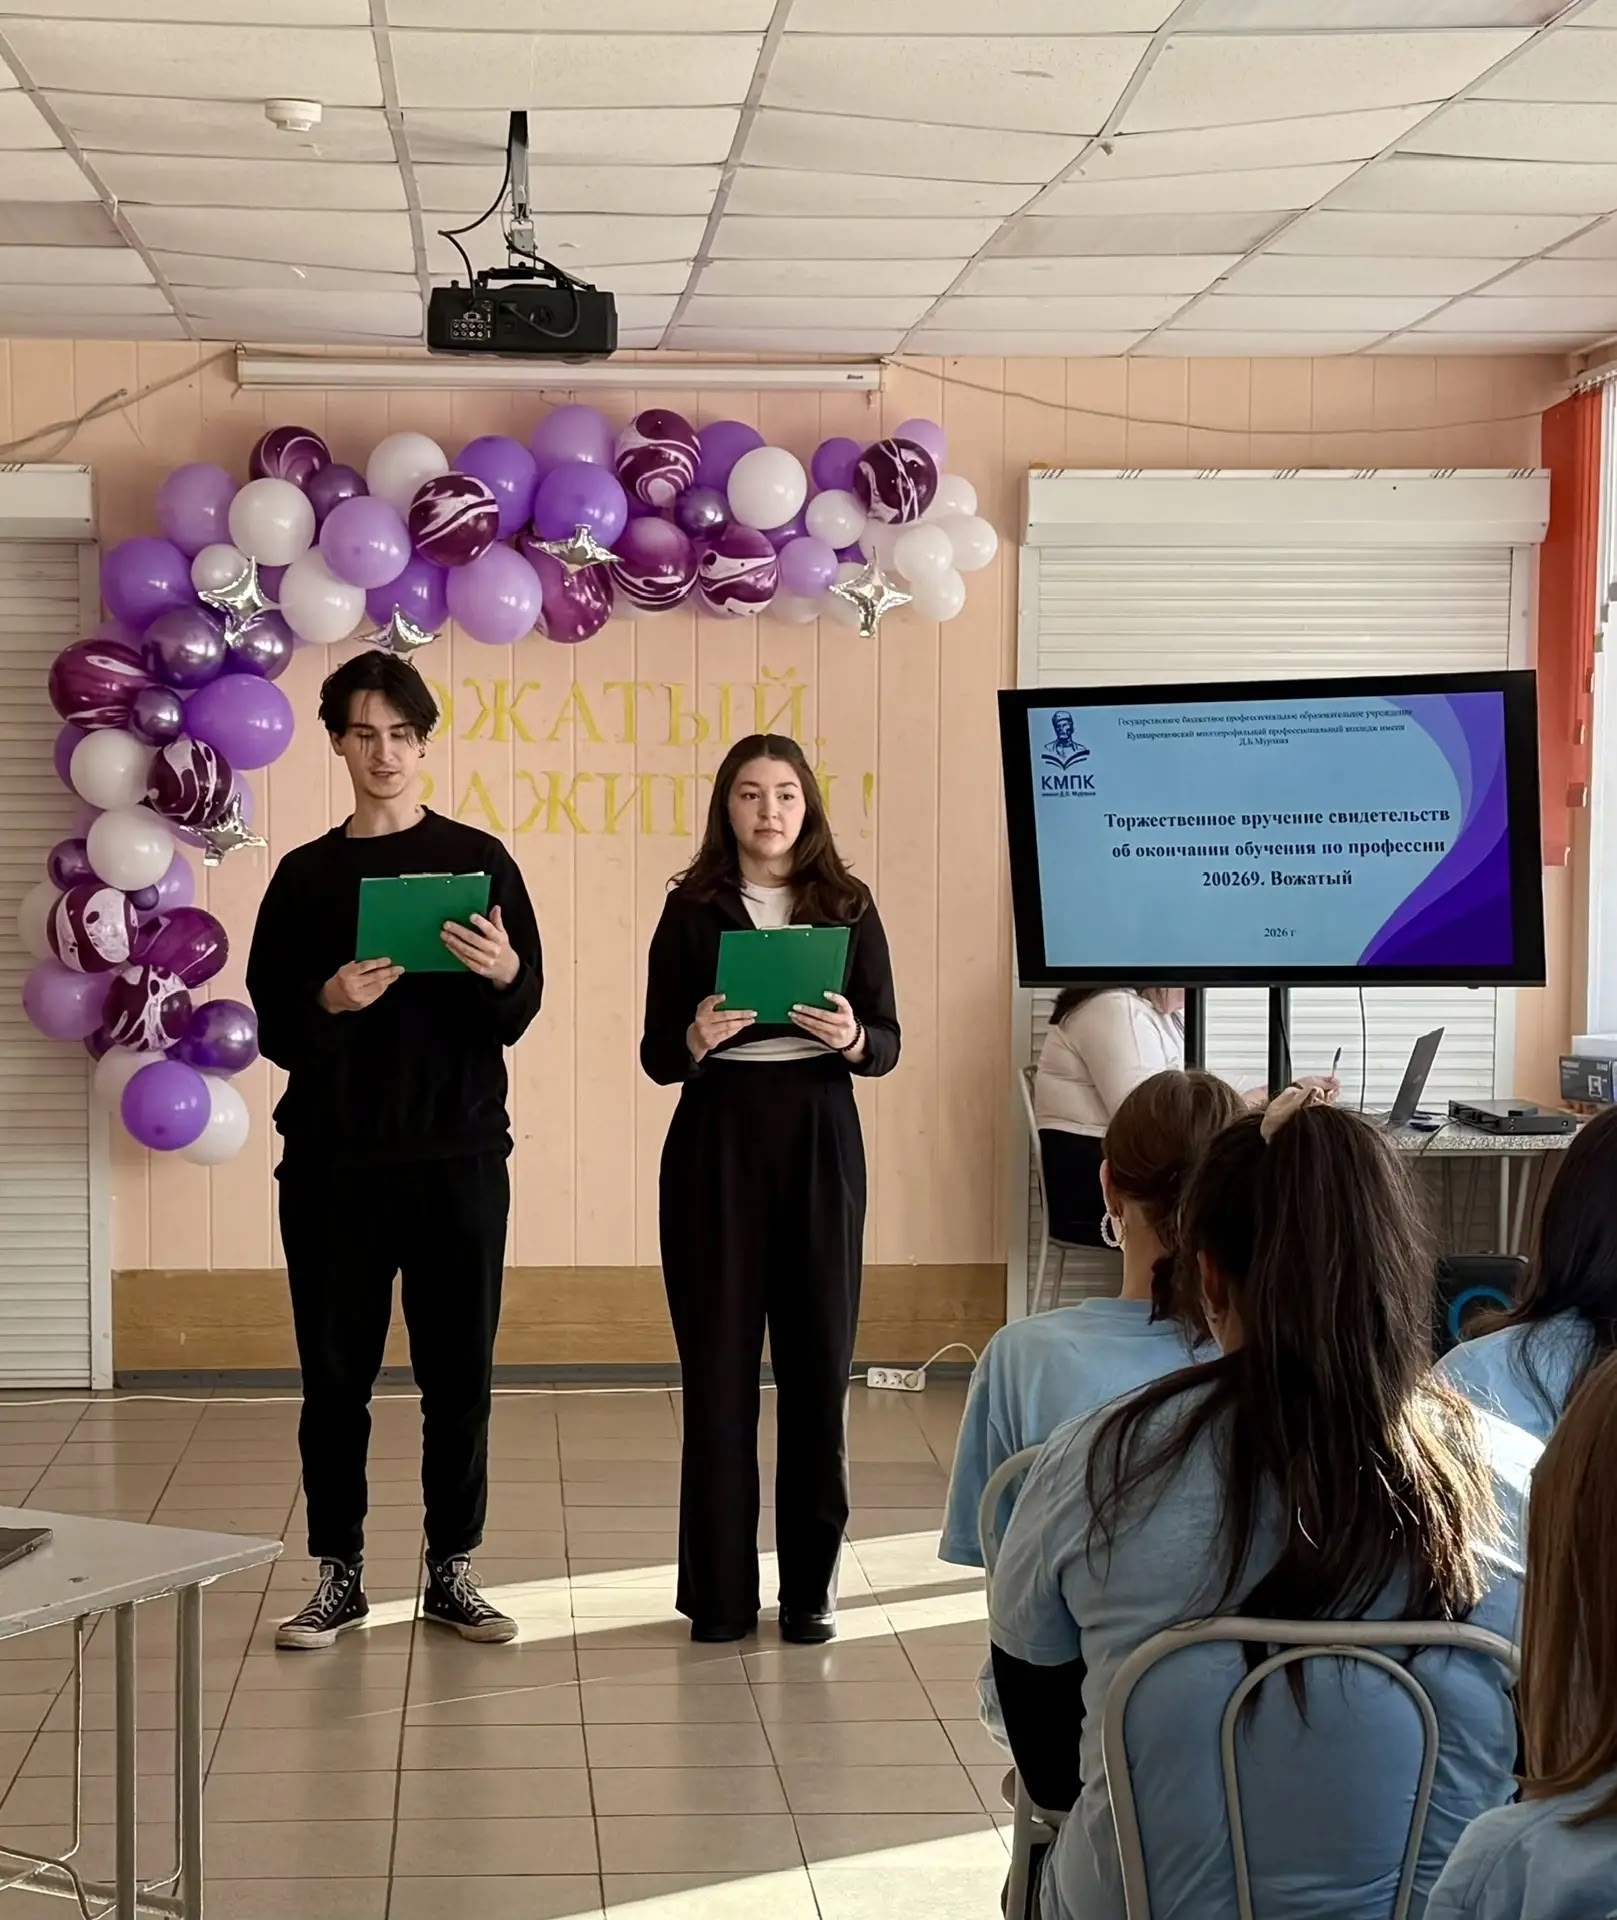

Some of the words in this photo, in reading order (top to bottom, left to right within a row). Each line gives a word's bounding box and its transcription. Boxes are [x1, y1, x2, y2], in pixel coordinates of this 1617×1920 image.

[1041, 774, 1095, 790] КМПК
[1104, 813, 1236, 831] Торжественное
[1241, 812, 1323, 829] вручение
[1328, 809, 1450, 824] свидетельств
[1112, 843, 1131, 857] об
[1135, 845, 1229, 858] окончании
[1235, 841, 1316, 859] обучения
[1322, 843, 1343, 855] по
[1349, 838, 1445, 857] профессии
[1202, 870, 1265, 886] 200269.
[1271, 869, 1352, 886] Вожатый
[1263, 927, 1288, 937] 2026
